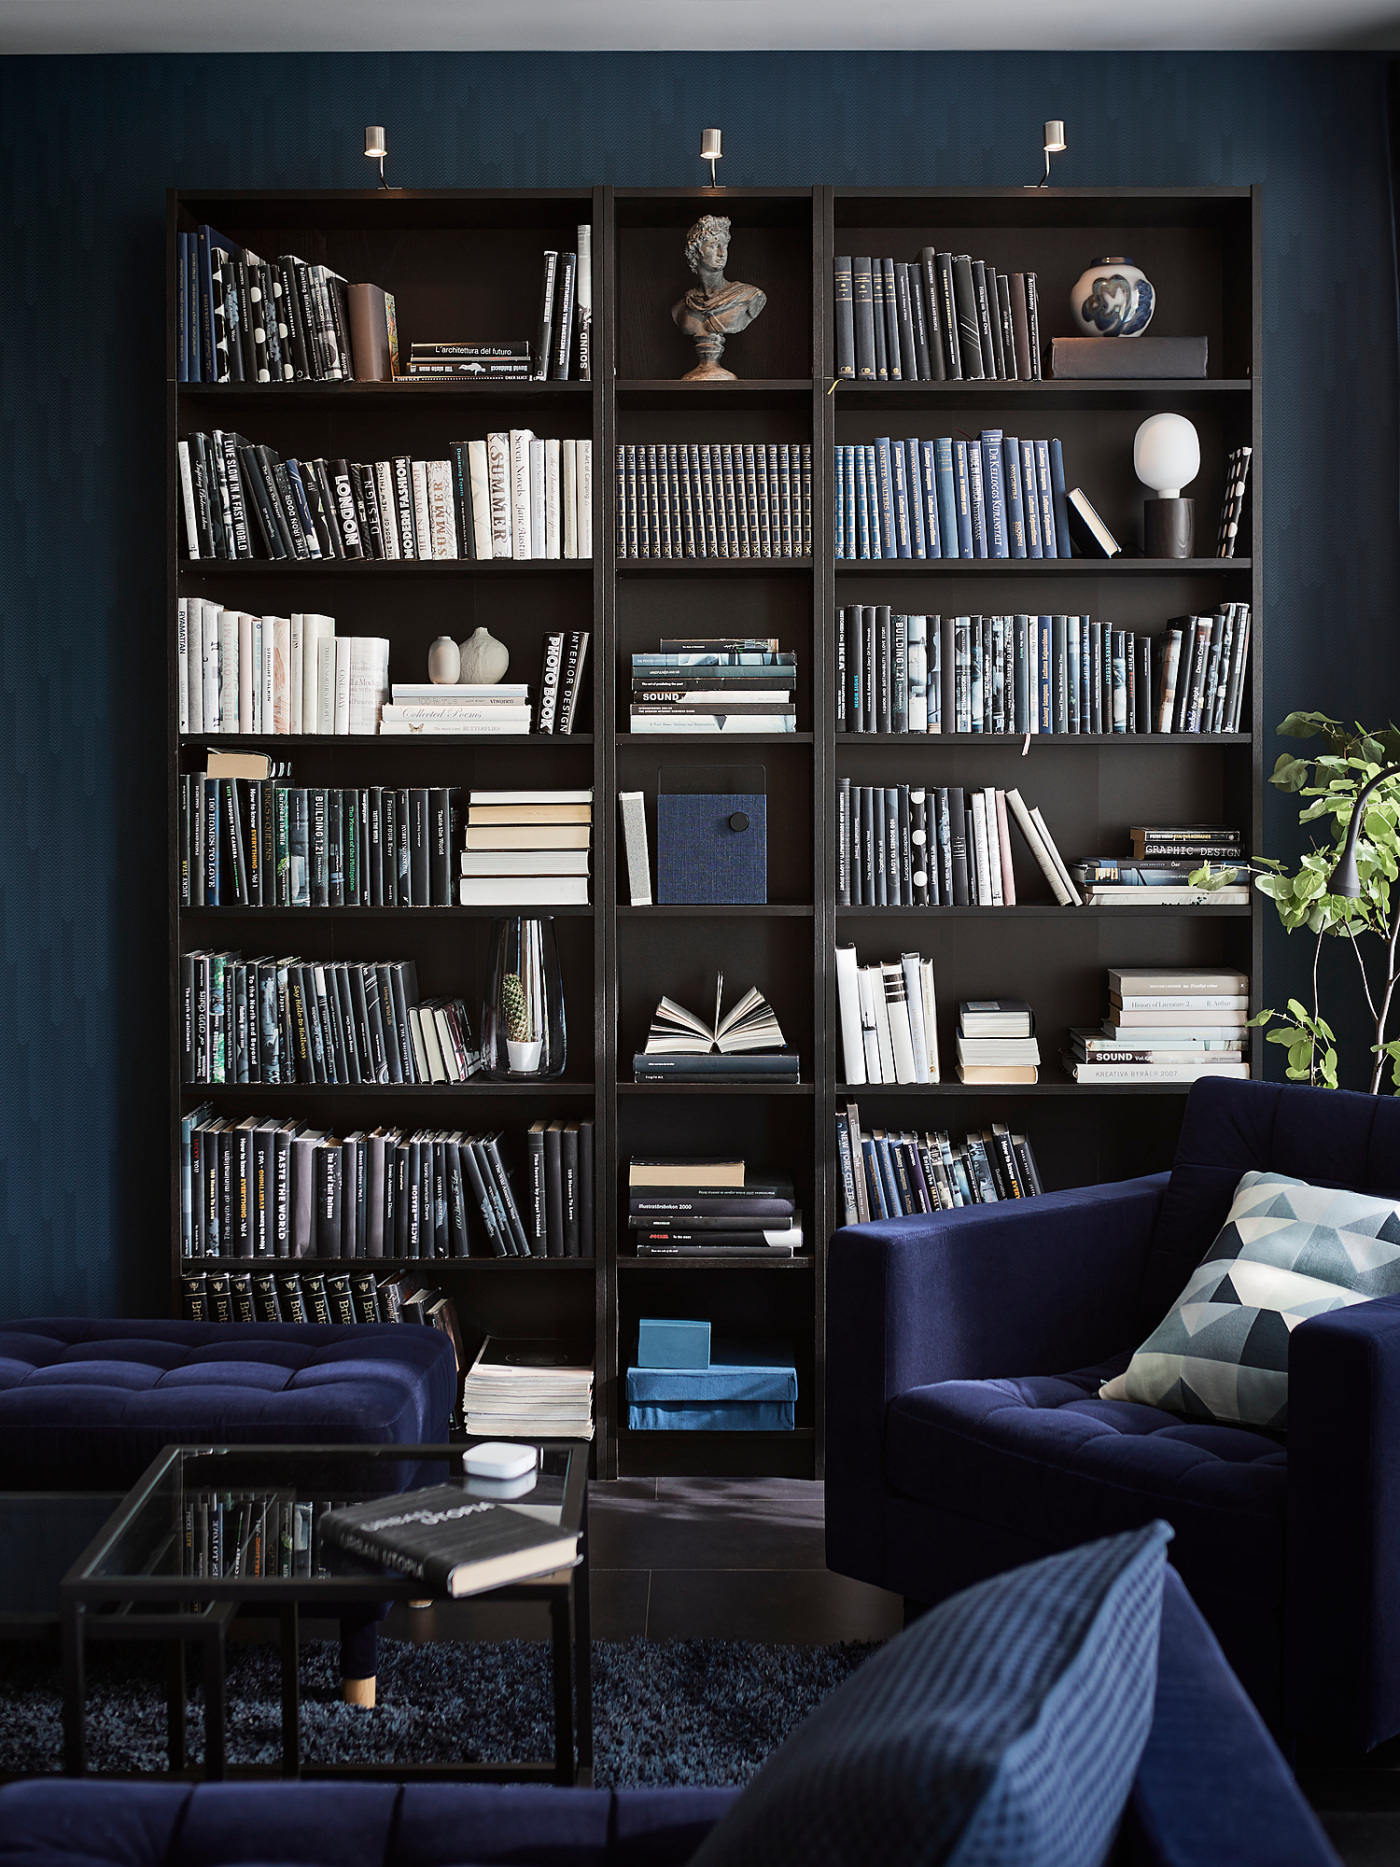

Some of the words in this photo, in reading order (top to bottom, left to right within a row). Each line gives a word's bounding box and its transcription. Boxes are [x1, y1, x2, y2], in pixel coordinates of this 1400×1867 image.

[299, 267, 307, 292] Painting
[303, 294, 312, 327] Miniatures
[435, 346, 478, 354] L'architettura
[480, 347, 491, 355] del
[493, 348, 511, 356] futuro
[224, 440, 235, 458] LIVE
[515, 436, 524, 462] Seven
[879, 445, 888, 477] MINETTE
[970, 449, 979, 467] MADE
[989, 448, 998, 460] DR
[227, 459, 238, 482] SLOW
[377, 463, 385, 492] THINGS
[395, 459, 409, 509] FASHION
[516, 466, 525, 497] Novels
[990, 461, 1001, 499] KELLOGGS
[230, 484, 239, 492] IN
[413, 469, 423, 513] OYEYEMI
[491, 452, 507, 541] SUMMER
[881, 478, 890, 510] WALTERS
[972, 475, 982, 501] AMERICA
[232, 502, 243, 521] FAST
[285, 494, 296, 516] DOOR
[334, 475, 359, 546] LONDON
[364, 481, 380, 535] DESIGN
[433, 480, 447, 556] SUMMER
[516, 504, 526, 525] Jane
[235, 523, 247, 551] WORLD
[290, 518, 300, 537] IRON
[401, 510, 413, 559] MODERN
[416, 519, 427, 551] HELEN
[992, 500, 1002, 546] KURANSTALT
[295, 538, 305, 553] THE
[518, 528, 528, 557] Austin
[222, 623, 232, 676] OYEYEMI
[895, 622, 904, 663] BUILDING
[545, 637, 560, 684] PHOTO
[566, 632, 579, 684] INTERIOR
[896, 666, 904, 681] 1.21
[224, 683, 234, 721] HELEN
[540, 687, 555, 730] BOOK
[560, 690, 572, 732] DESIGN
[643, 693, 679, 701] SOUND
[402, 707, 444, 718] Collected
[448, 708, 482, 718] Poems
[208, 813, 216, 846] HOMES
[315, 796, 323, 837] BUILDING
[208, 847, 215, 861] TO
[315, 840, 323, 855] 1.21
[890, 850, 896, 858] TO
[1145, 845, 1194, 856] GRAPHIC
[1200, 848, 1242, 857] DESIGN
[208, 863, 216, 888] LOVE
[248, 975, 254, 983] To
[293, 985, 301, 998] Say
[295, 999, 304, 1017] Hello
[298, 1027, 307, 1060] Hallways
[1096, 1070, 1128, 1078] KREATIVA
[1131, 1069, 1158, 1078] BYRÅER
[840, 1131, 850, 1149] NEW
[223, 1150, 231, 1193] minimalism
[277, 1150, 286, 1180] TASTE
[842, 1150, 852, 1172] YORK
[278, 1182, 286, 1202] THE
[845, 1173, 854, 1189] CITY
[922, 1155, 930, 1173] Enjoy
[929, 1186, 938, 1207] SMALL
[995, 1168, 1005, 1197] Sustainable
[224, 1195, 231, 1203] of
[278, 1204, 287, 1240] WORLD
